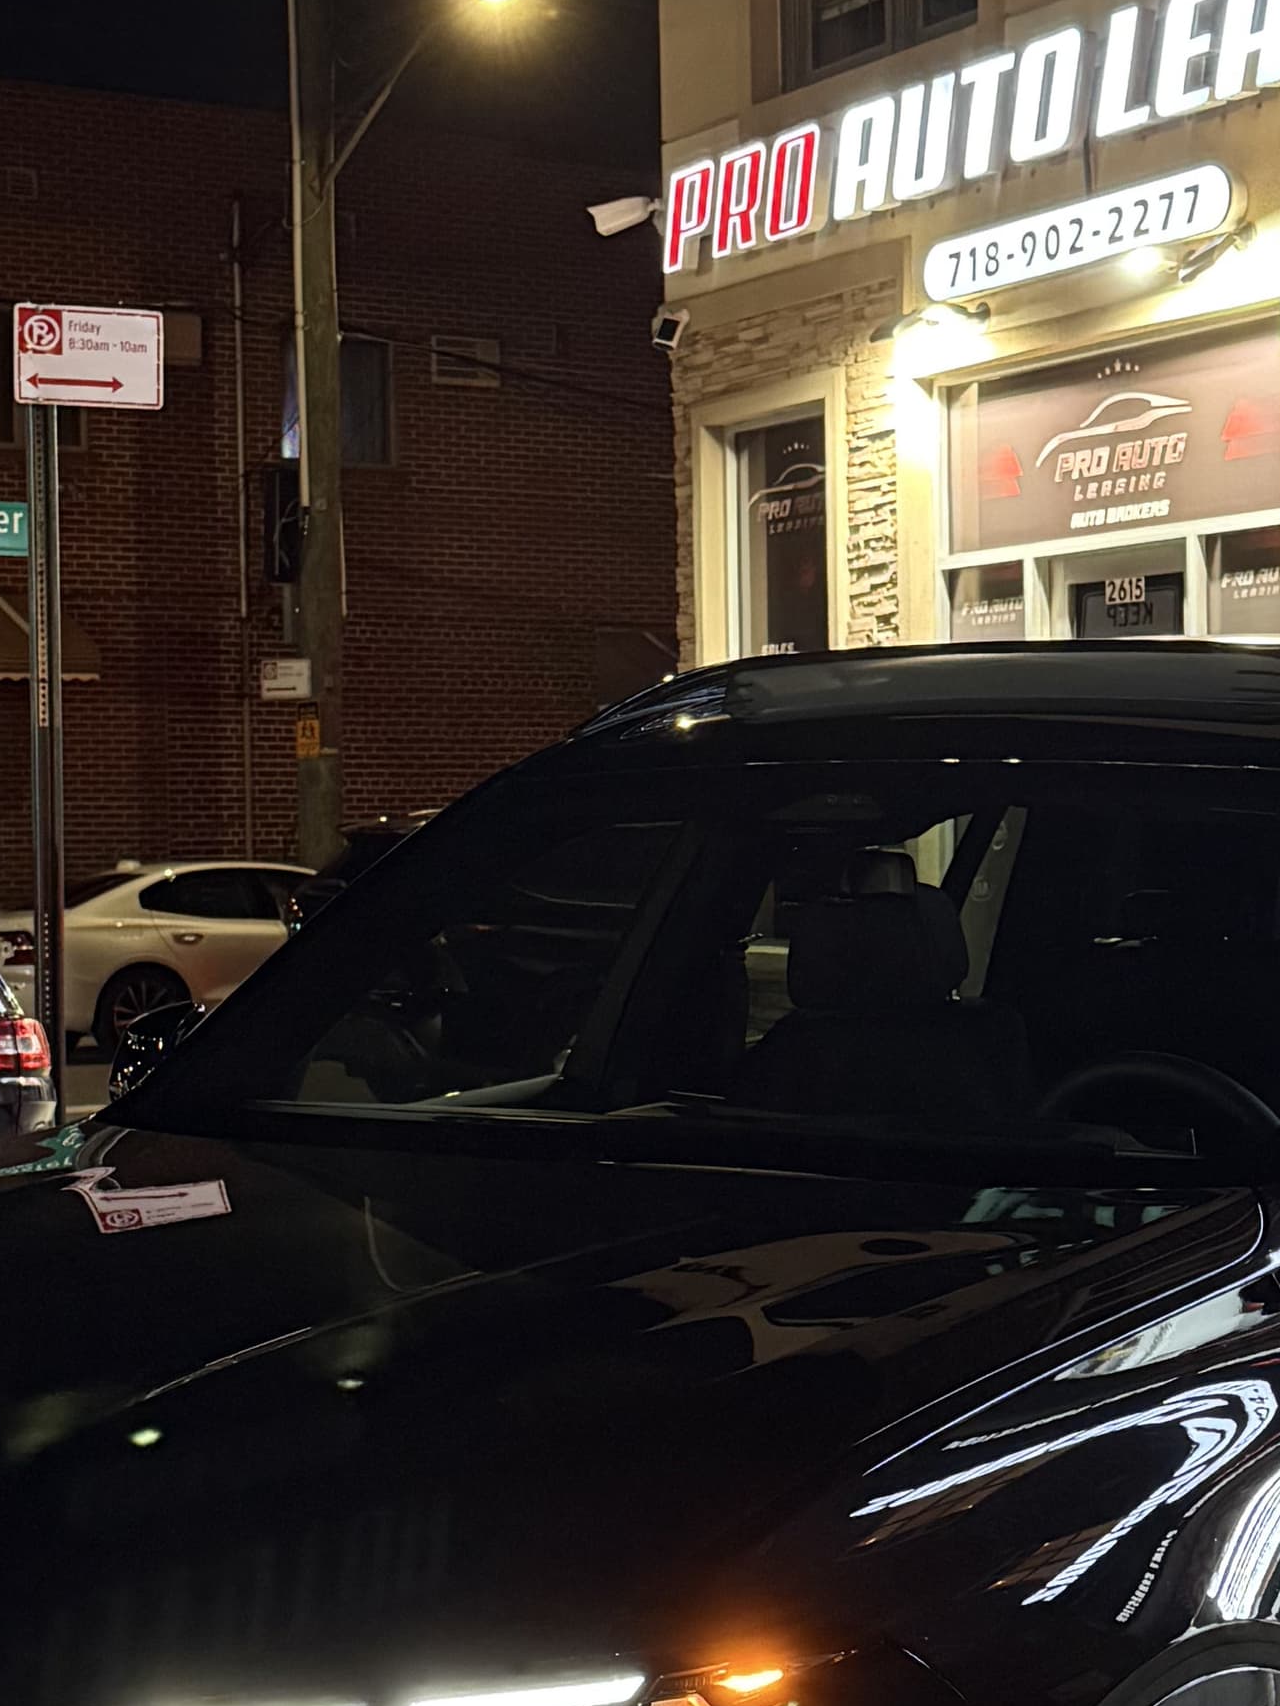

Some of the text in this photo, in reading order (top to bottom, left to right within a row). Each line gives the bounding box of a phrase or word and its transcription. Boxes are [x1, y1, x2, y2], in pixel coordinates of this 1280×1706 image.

[663, 122, 820, 273] PRO
[833, 27, 1082, 221] AUTO
[948, 186, 1200, 288] 718-902-2277
[69, 320, 102, 335] Friday
[68, 338, 110, 352] 8:30am
[120, 341, 147, 353] 10am
[1054, 432, 1188, 483] PRO AUTO
[1073, 471, 1167, 502] LEASING
[1106, 579, 1144, 603] 2615
